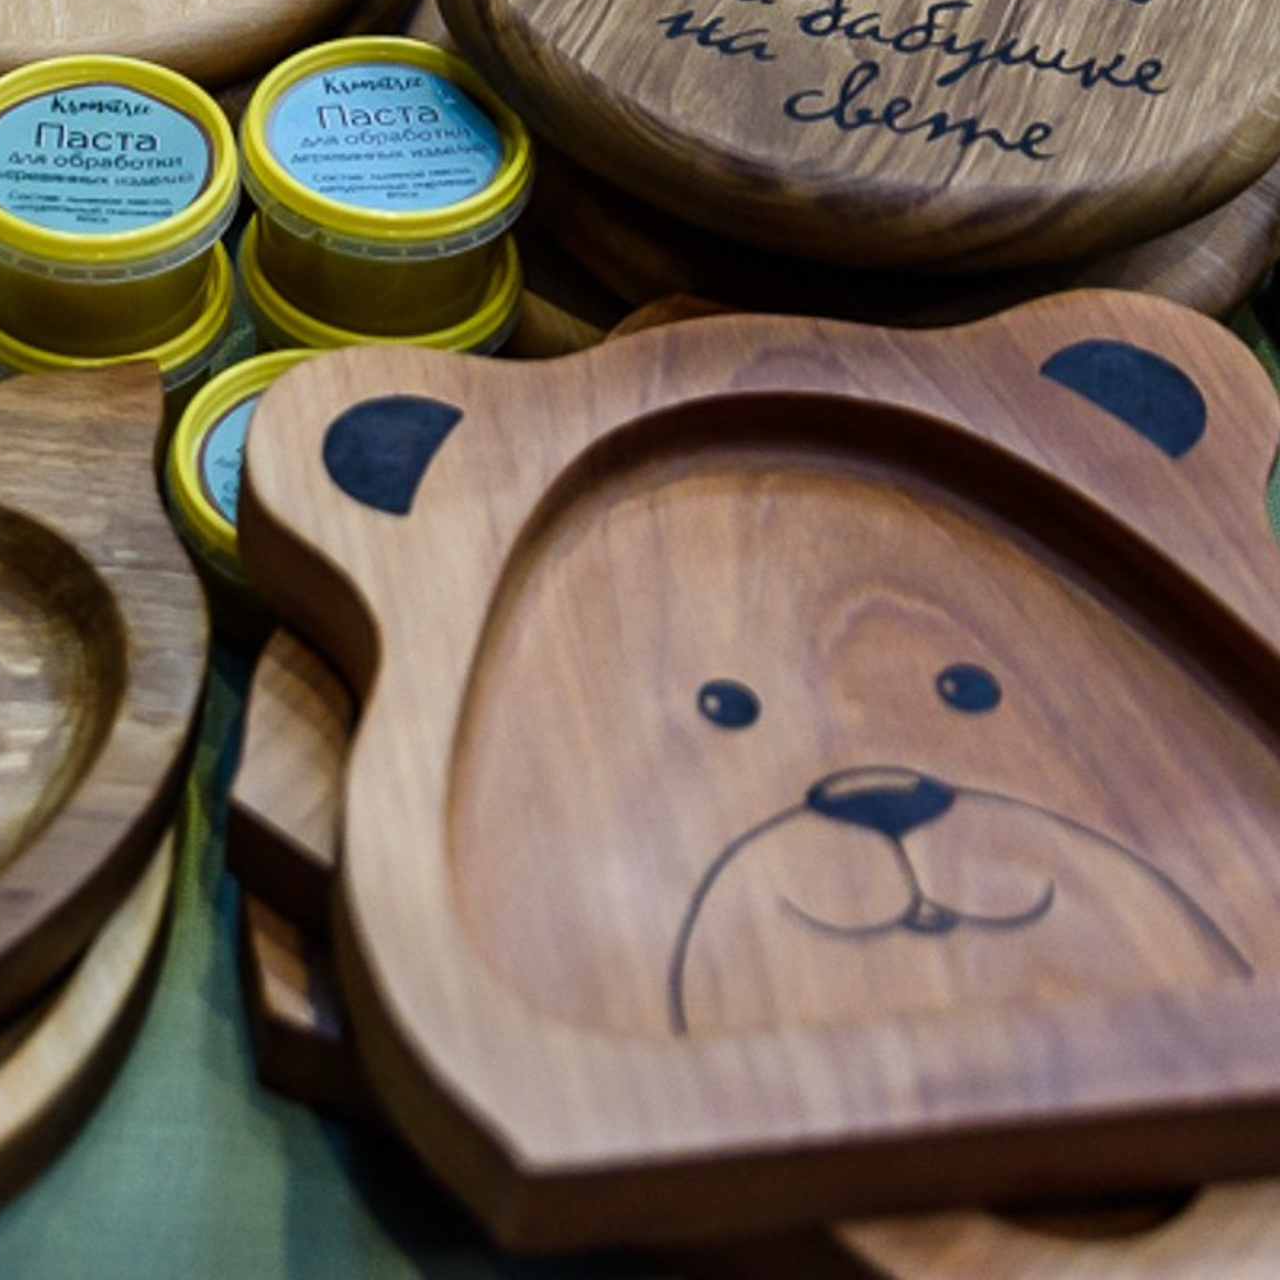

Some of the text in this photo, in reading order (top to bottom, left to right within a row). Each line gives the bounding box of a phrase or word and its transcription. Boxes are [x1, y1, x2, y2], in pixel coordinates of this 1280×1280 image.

[658, 9, 777, 62] на
[316, 104, 440, 130] Паста
[783, 61, 1058, 161] свете
[34, 121, 159, 152] Паста
[300, 126, 472, 148] для обработки
[8, 151, 183, 170] для обработки
